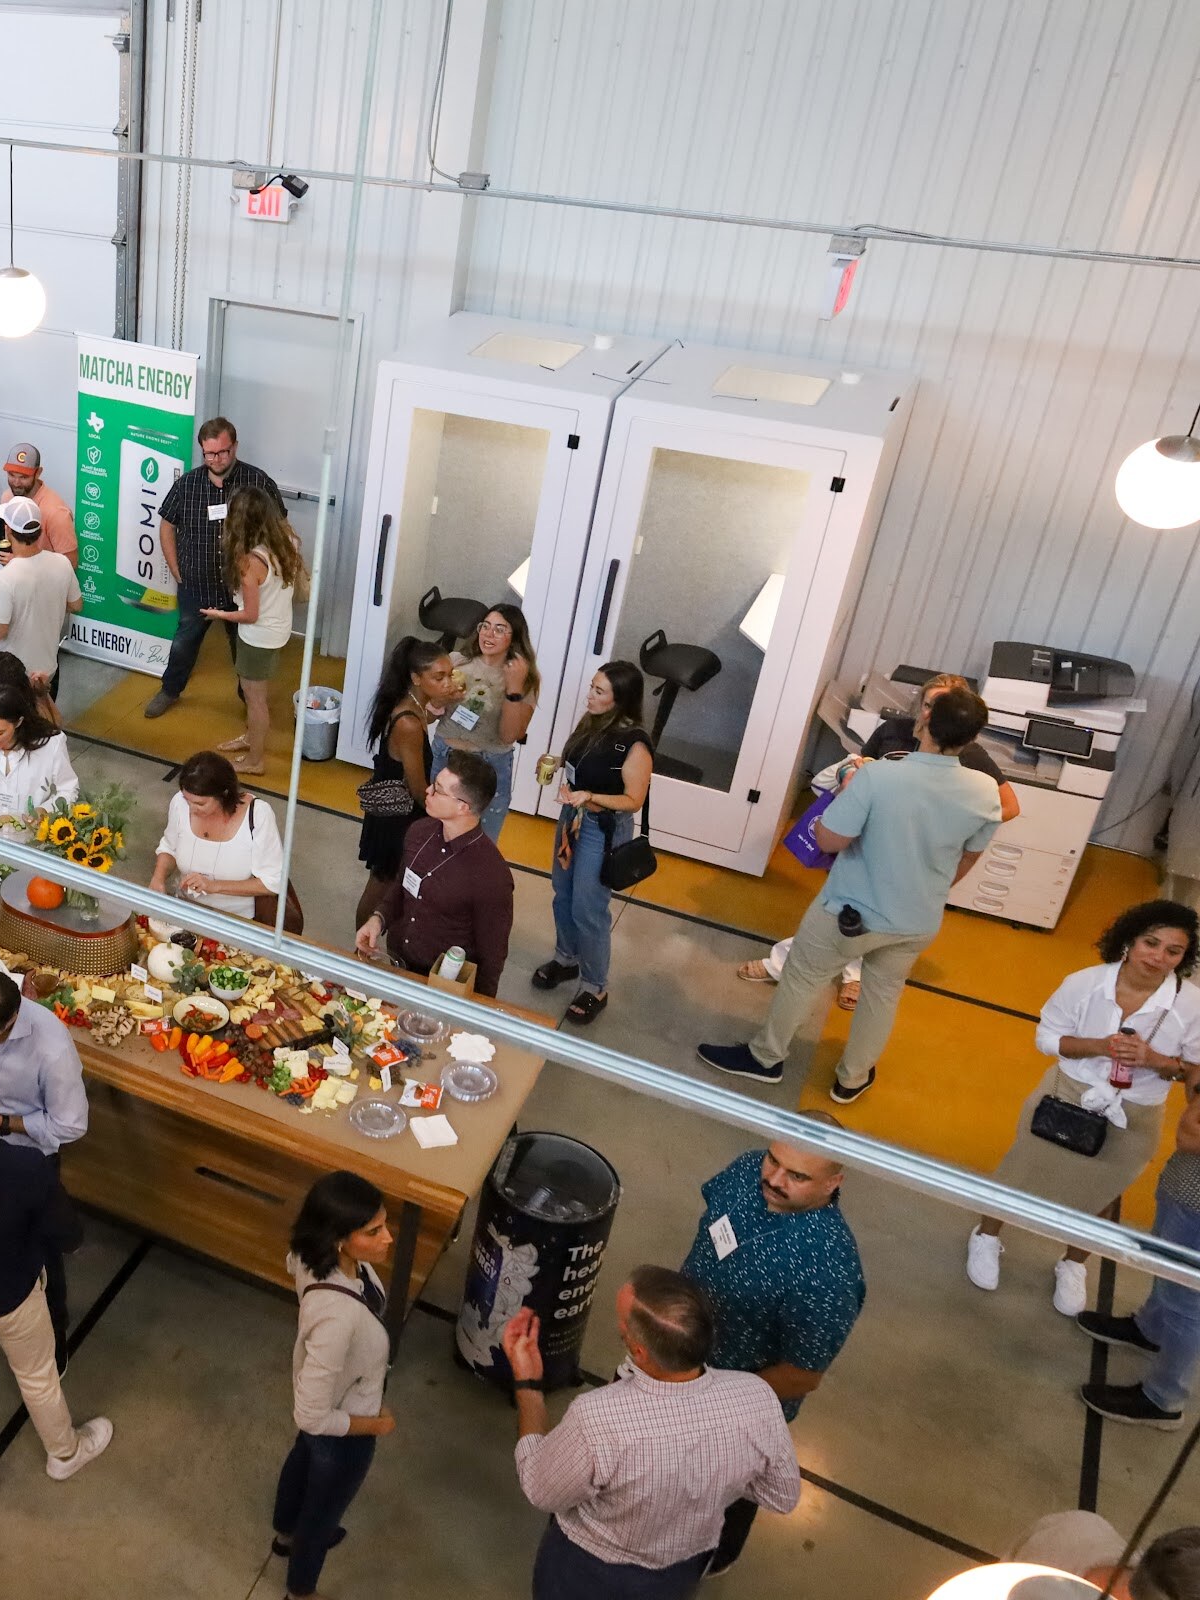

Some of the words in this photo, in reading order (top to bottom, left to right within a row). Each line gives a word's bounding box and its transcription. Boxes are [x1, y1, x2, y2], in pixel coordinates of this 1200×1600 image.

[248, 187, 282, 216] EXIT
[79, 353, 134, 388] MATCHA
[138, 365, 192, 400] ENERGY
[138, 488, 157, 580] SOMI
[70, 624, 88, 643] ALL
[91, 629, 132, 654] ENERGY
[131, 640, 145, 658] No
[568, 1241, 604, 1262] The
